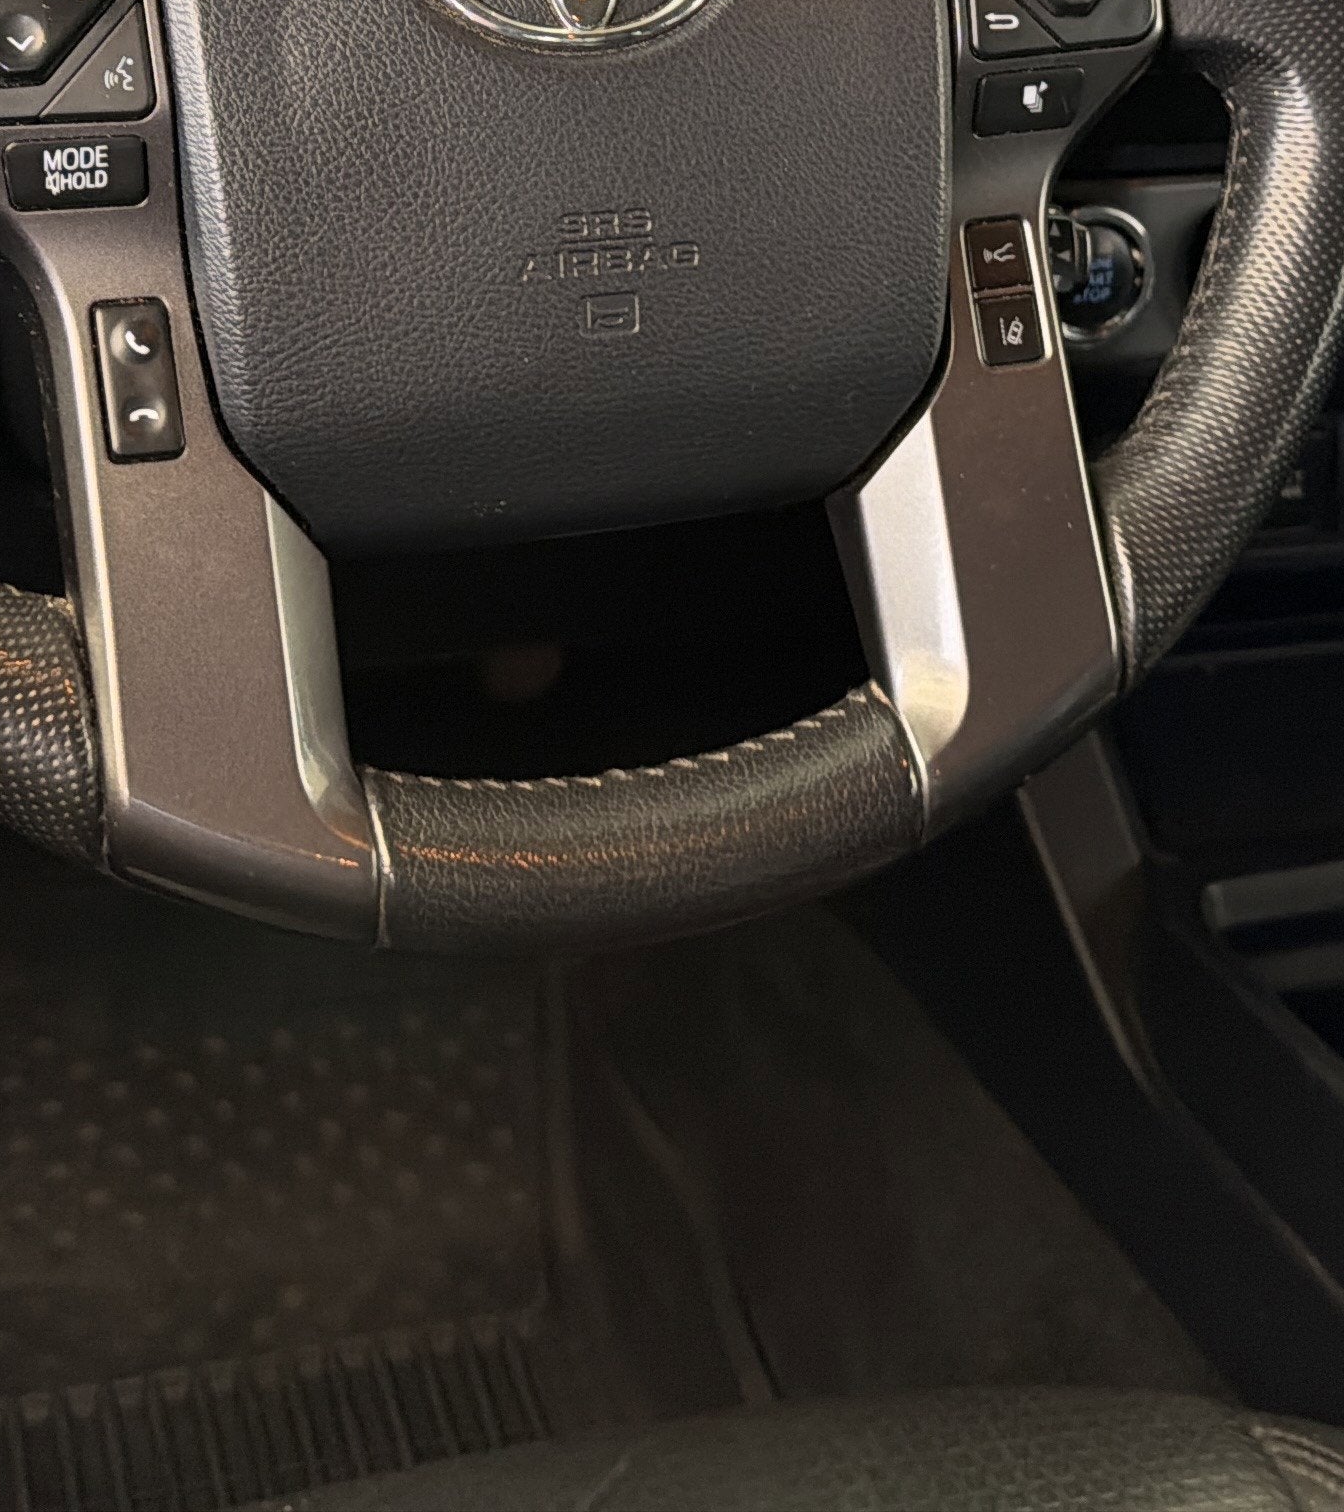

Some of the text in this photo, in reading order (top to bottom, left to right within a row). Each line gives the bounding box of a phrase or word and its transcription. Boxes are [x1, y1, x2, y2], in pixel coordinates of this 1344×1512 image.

[43, 145, 109, 170] MODE
[59, 169, 108, 191] HOLD
[521, 242, 700, 282] AIRBAG
